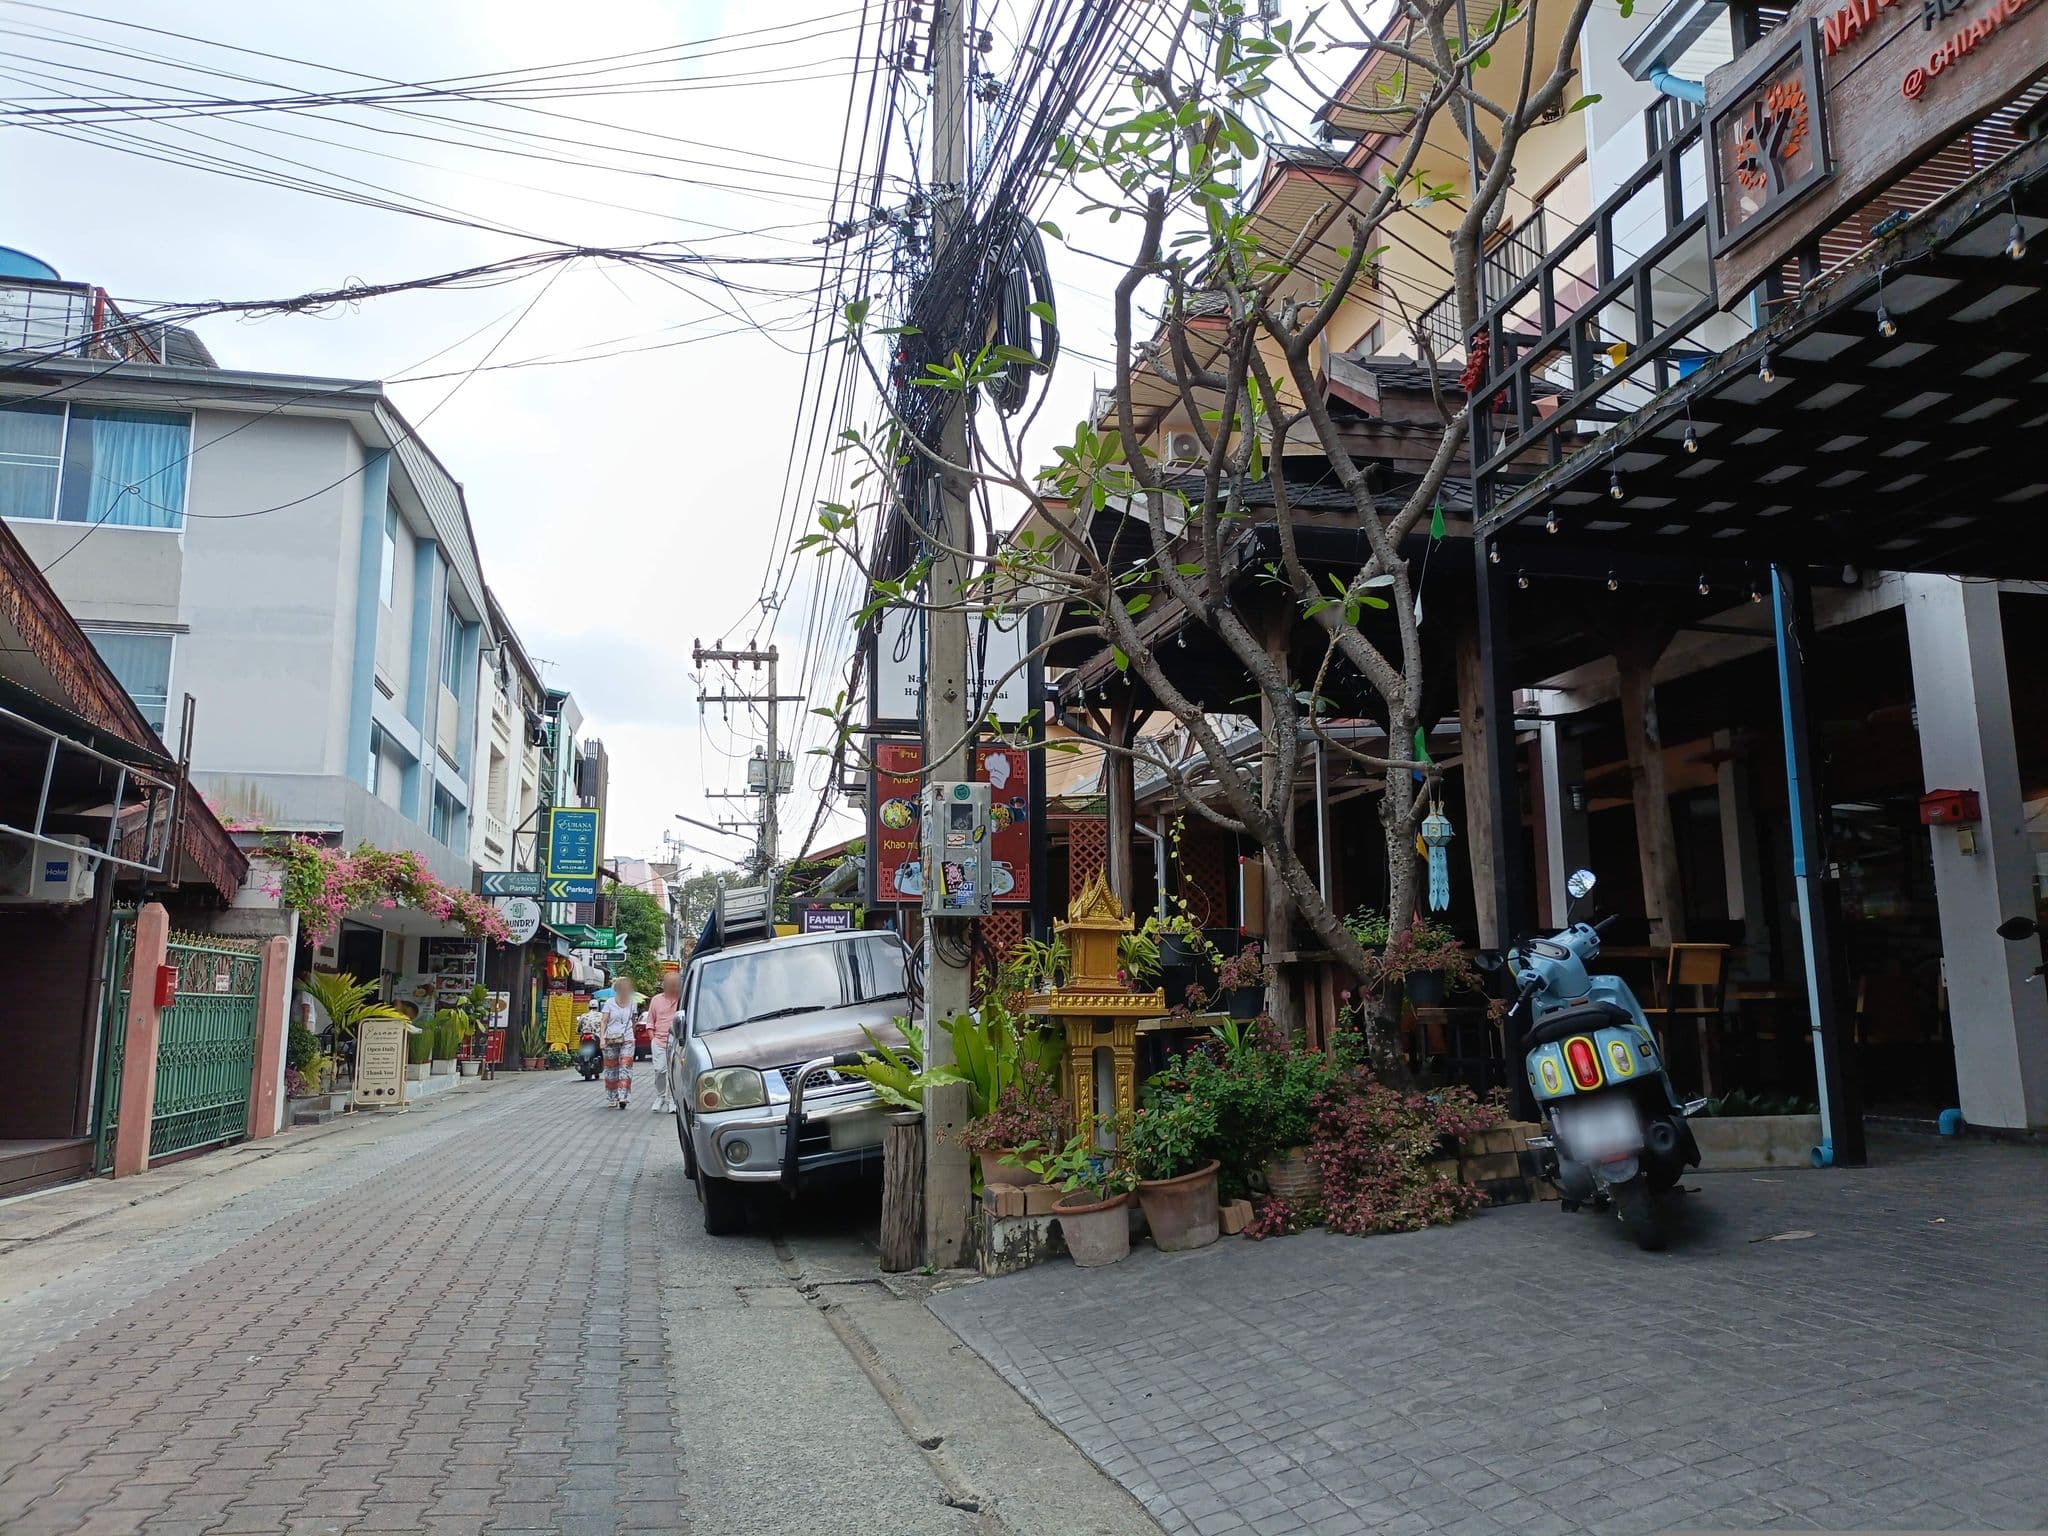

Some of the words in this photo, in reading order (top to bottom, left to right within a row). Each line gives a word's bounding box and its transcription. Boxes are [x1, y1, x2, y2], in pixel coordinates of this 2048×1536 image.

[1823, 0, 1891, 56] NAT
[883, 840, 906, 849] Khao
[509, 885, 537, 894] Parking
[566, 886, 593, 894] Parking
[809, 915, 845, 924] FAMILY
